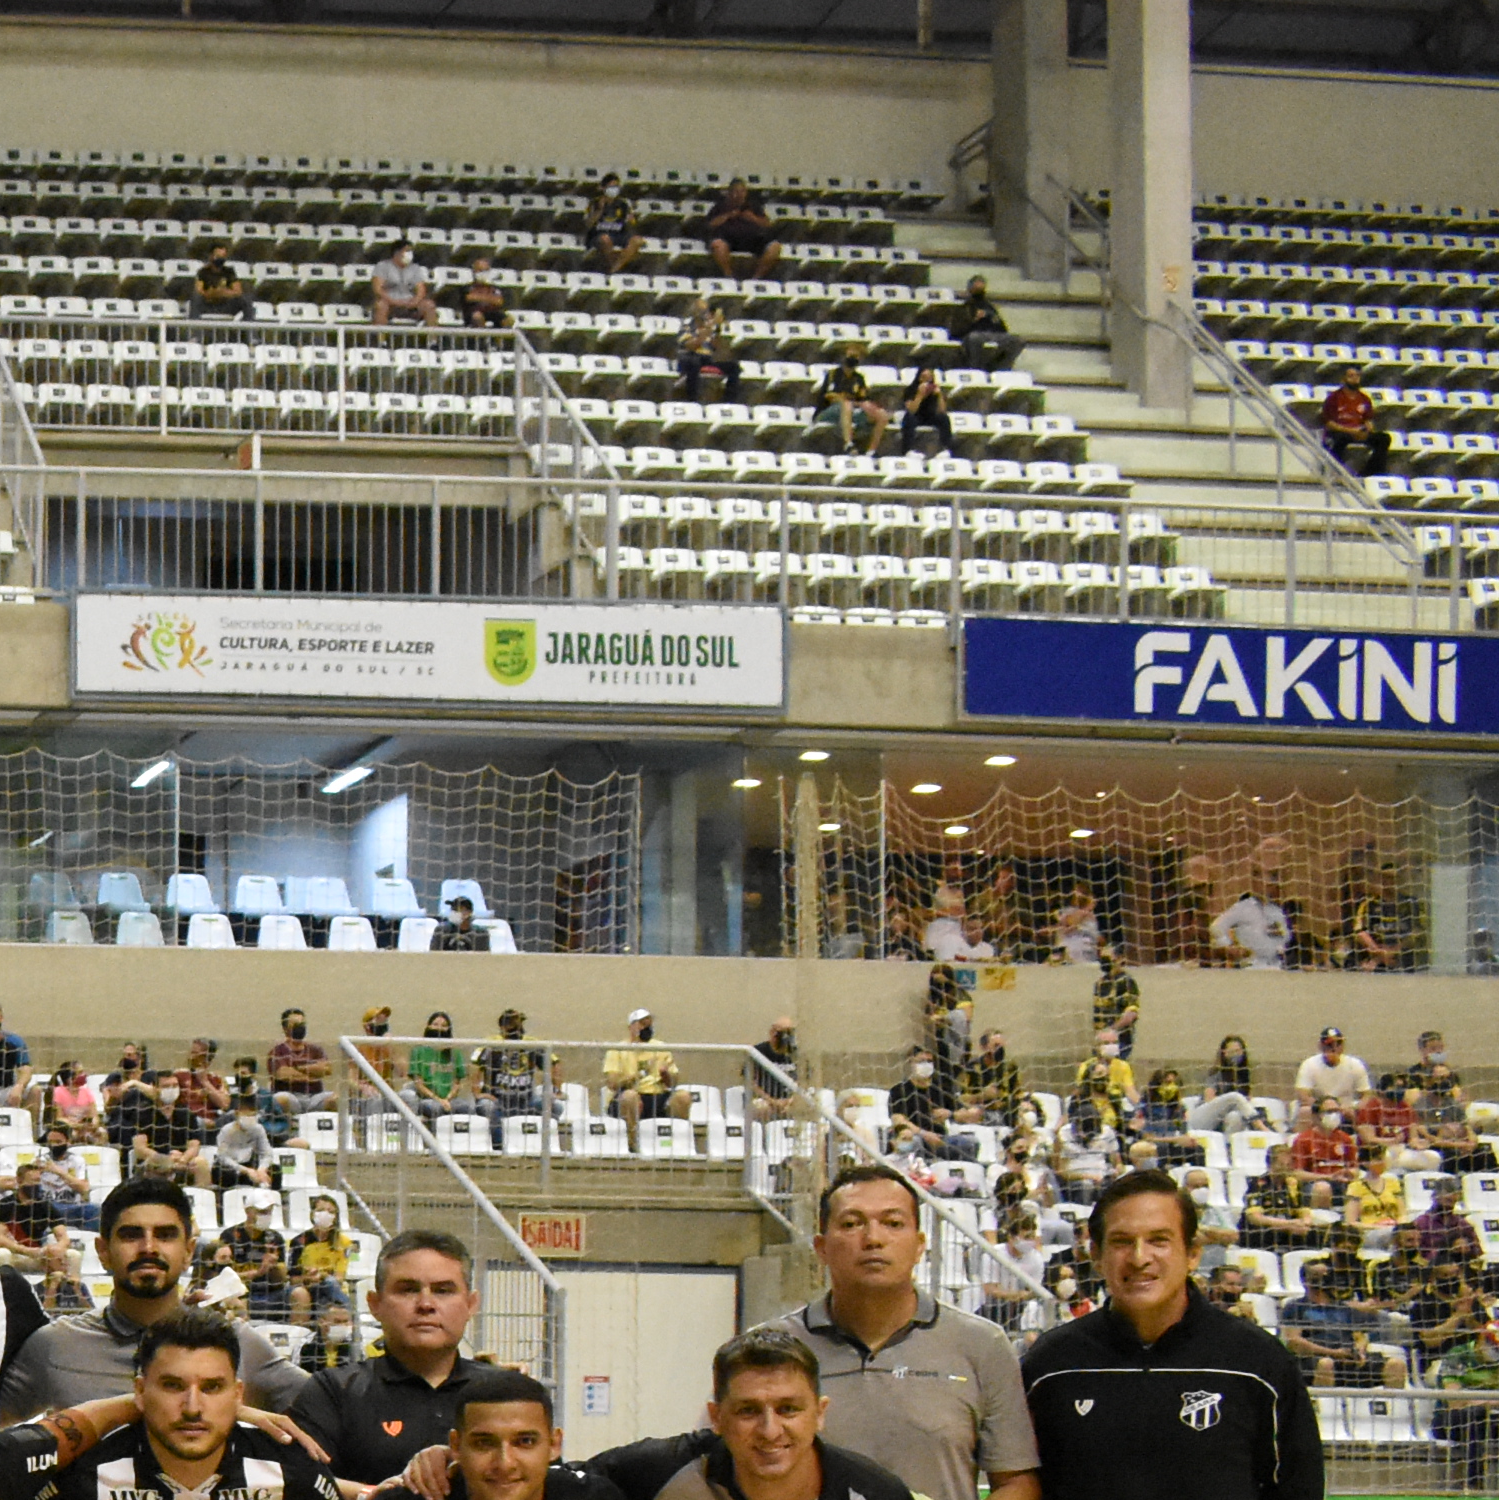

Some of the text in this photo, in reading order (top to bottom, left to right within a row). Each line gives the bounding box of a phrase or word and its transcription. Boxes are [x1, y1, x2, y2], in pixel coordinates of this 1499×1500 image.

[219, 617, 383, 635] Secretaria Municipal de
[219, 636, 435, 655] CULTURA, ESPORTE E LAZER
[545, 629, 740, 668] JARAGUÁ DO SUL
[589, 671, 697, 686] PREFEITURA
